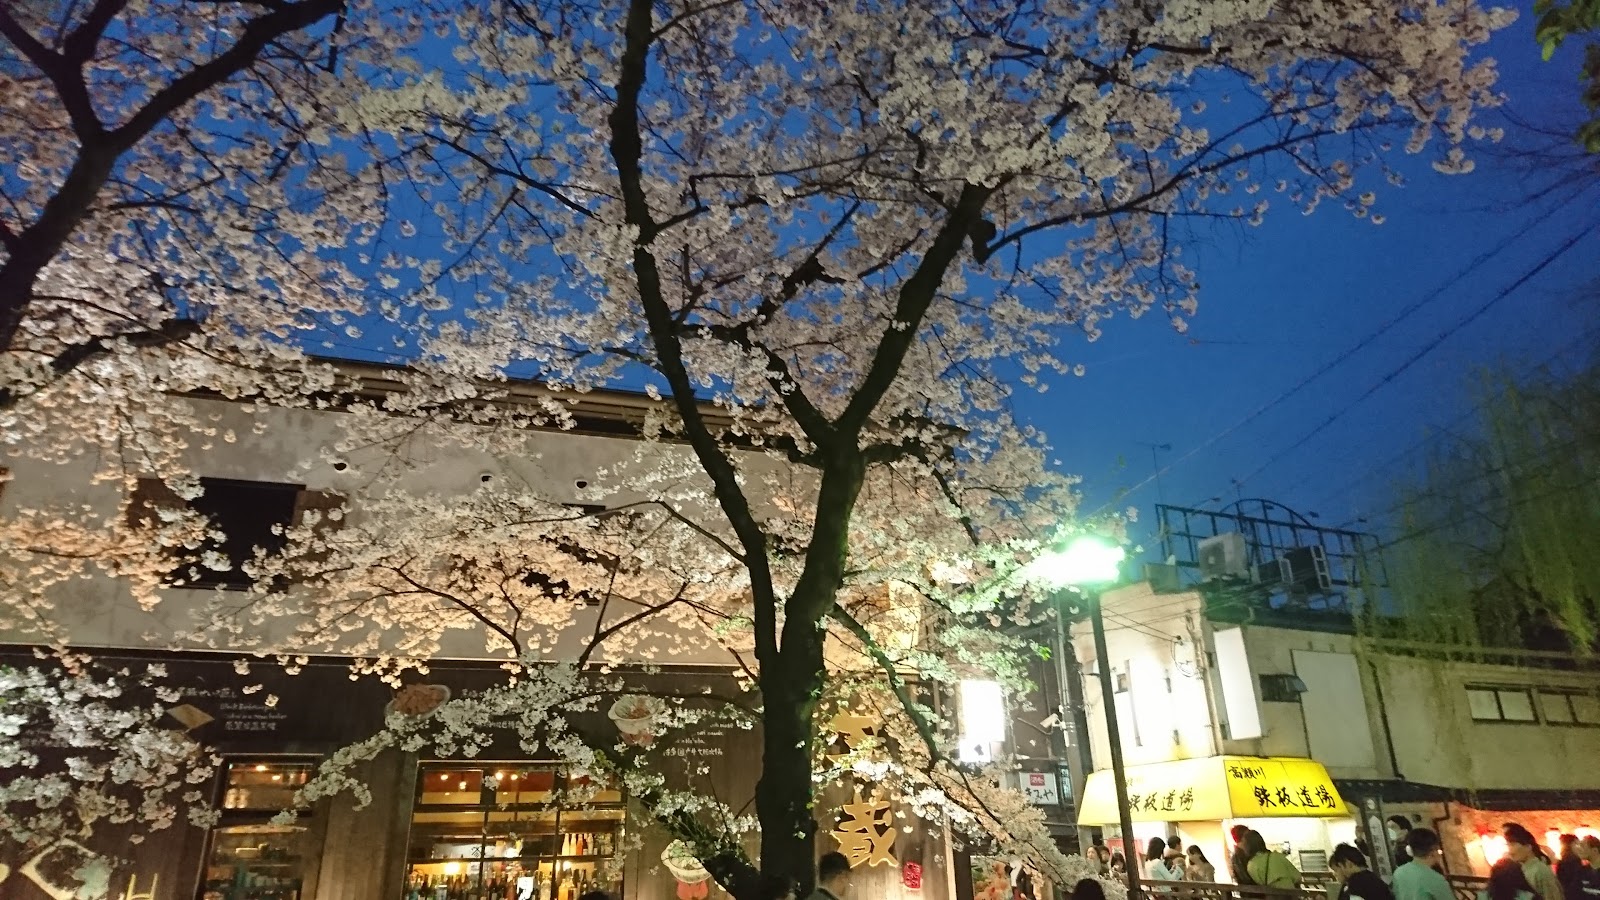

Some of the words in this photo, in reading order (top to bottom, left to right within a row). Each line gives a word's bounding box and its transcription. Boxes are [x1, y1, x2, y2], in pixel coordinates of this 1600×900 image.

[1229, 765, 1266, 779] 高瀬川
[1254, 784, 1336, 809] 鉄板道場
